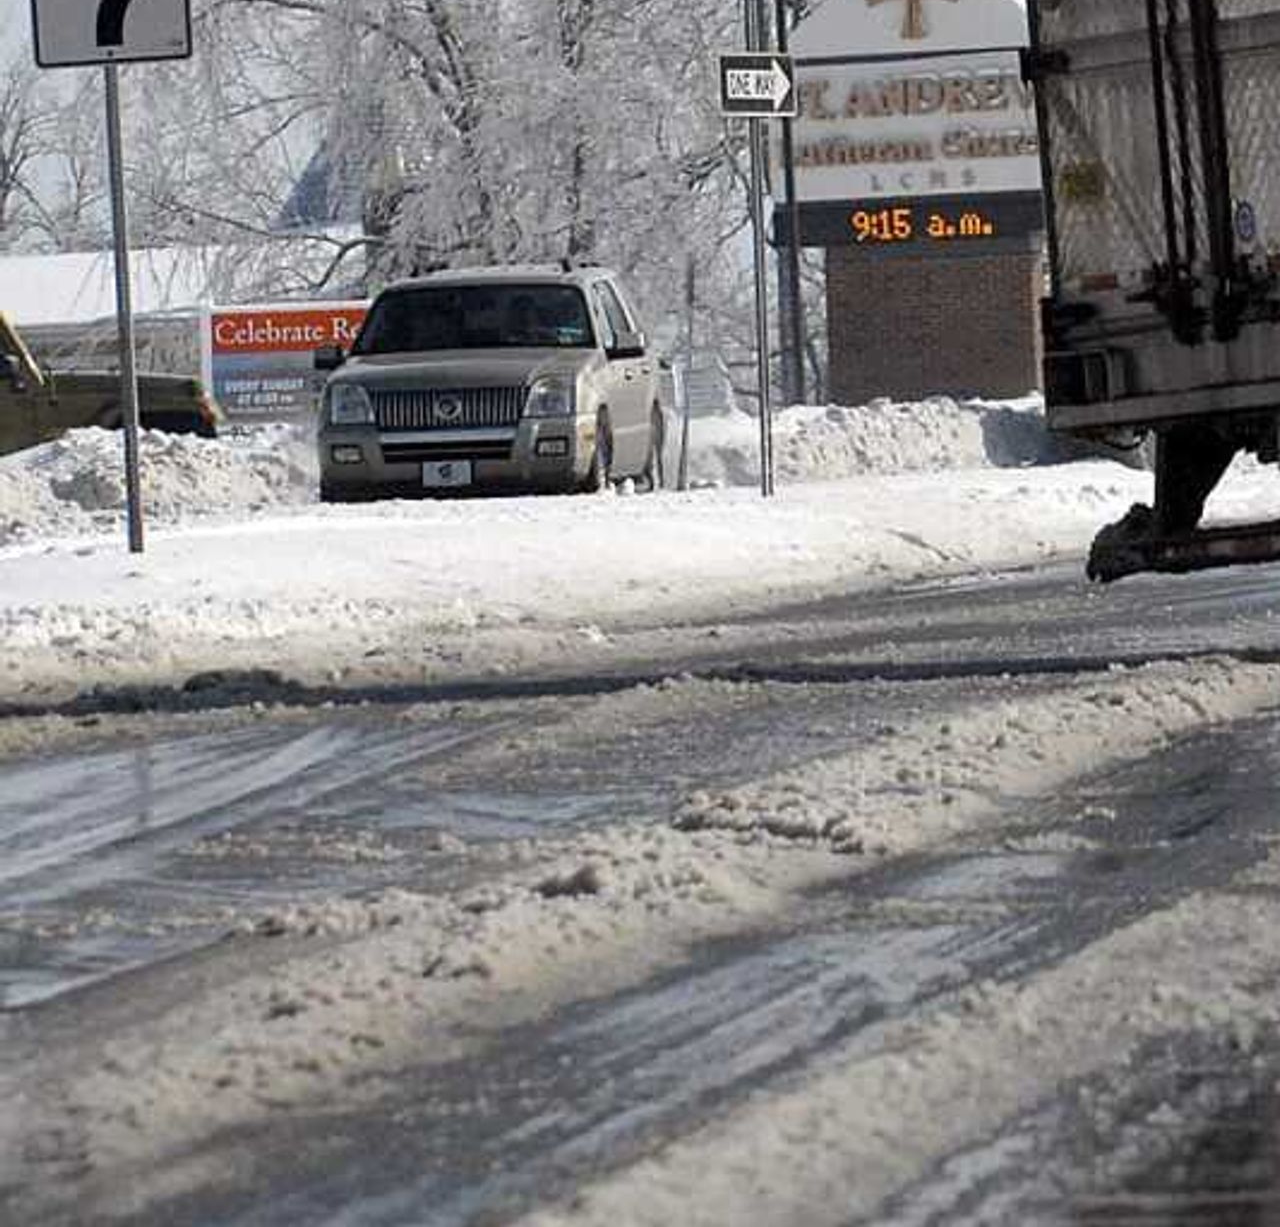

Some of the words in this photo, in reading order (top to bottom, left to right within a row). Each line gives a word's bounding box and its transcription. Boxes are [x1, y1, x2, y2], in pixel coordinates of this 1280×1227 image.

[730, 72, 751, 96] ONE
[852, 209, 912, 241] 9:15
[926, 213, 993, 238] a.m.
[215, 319, 324, 345] Celebrate
